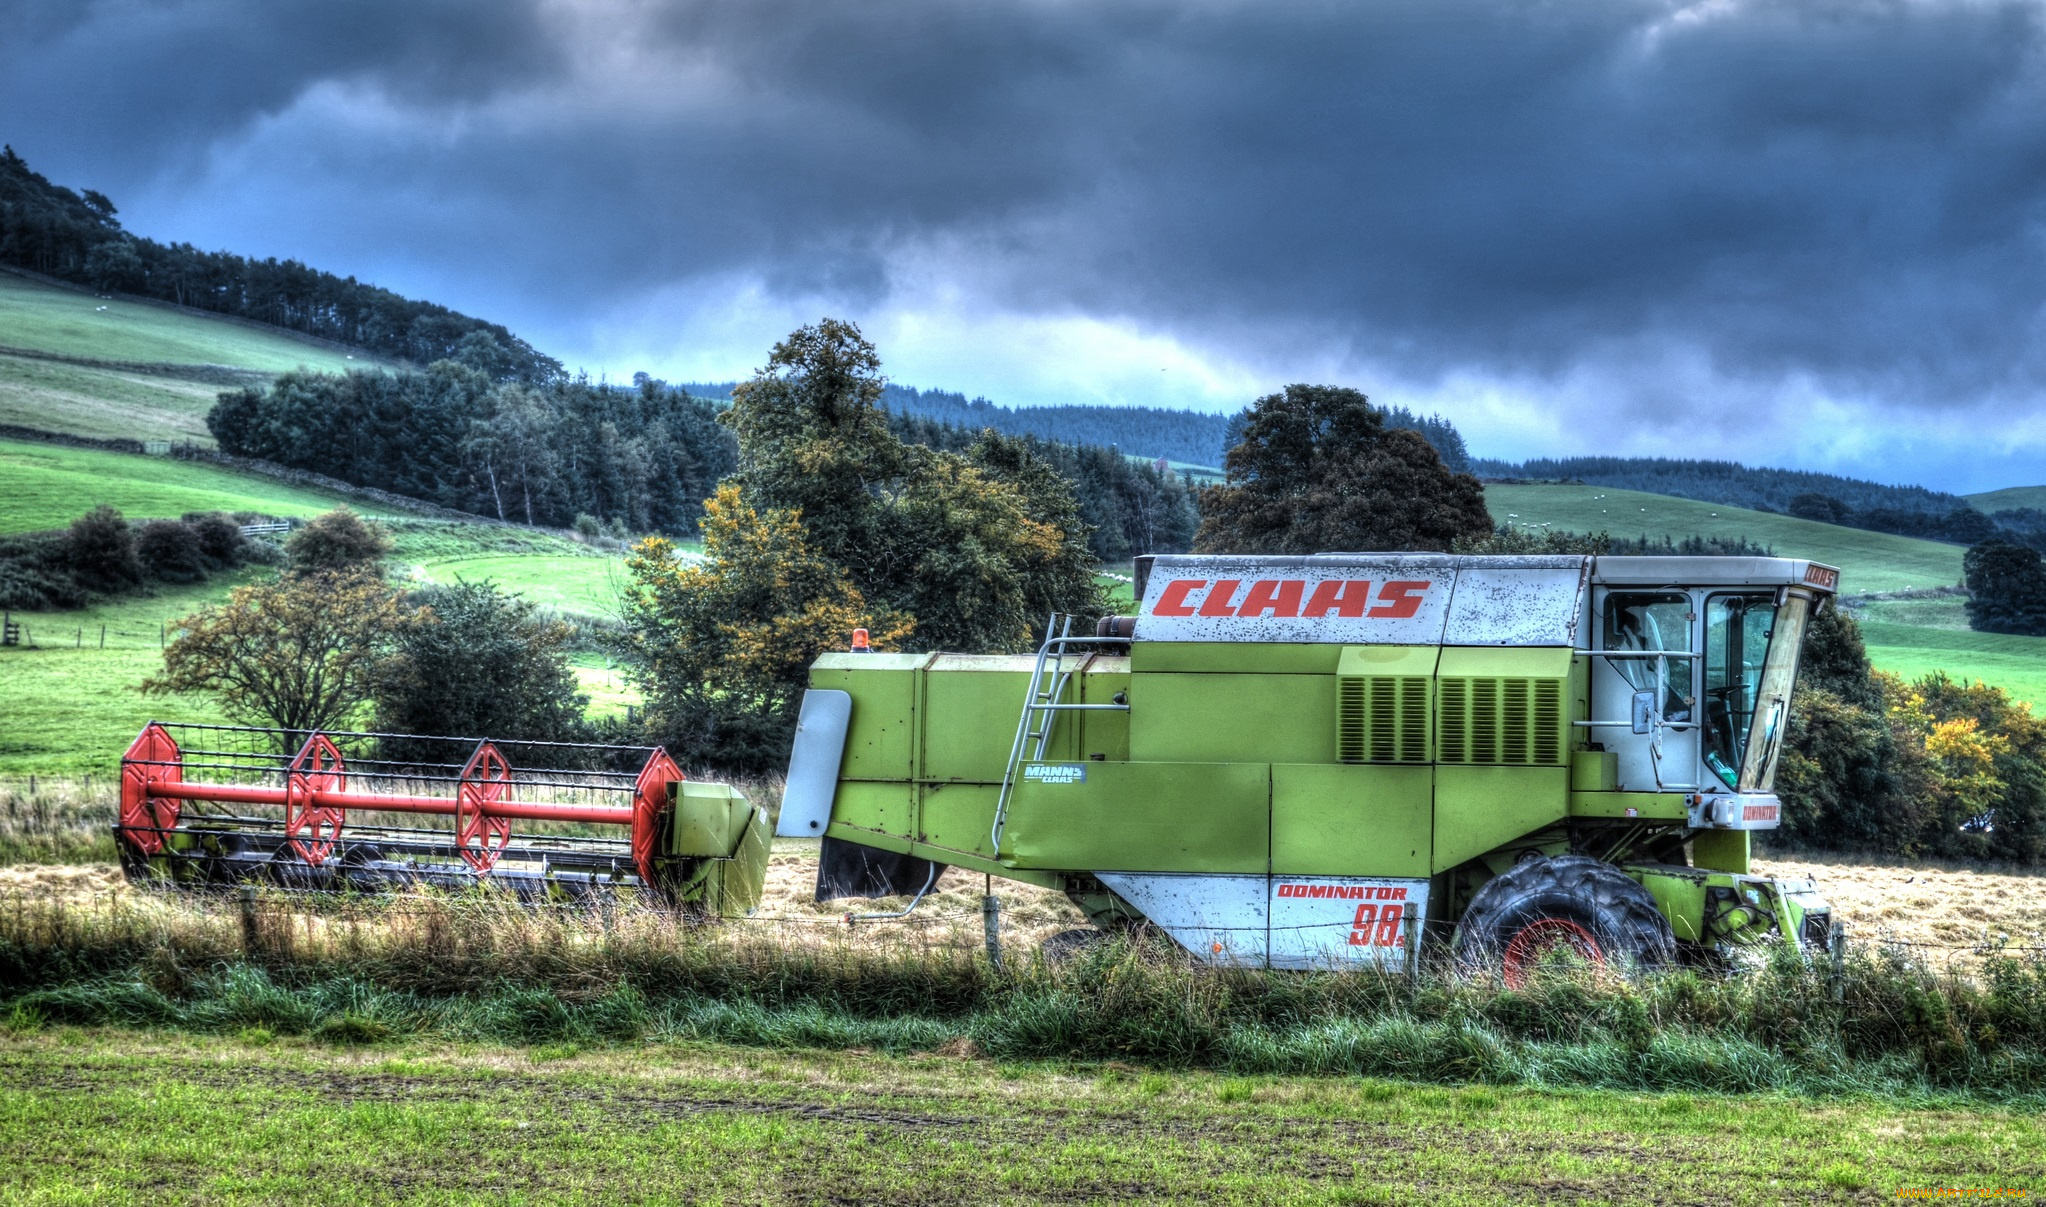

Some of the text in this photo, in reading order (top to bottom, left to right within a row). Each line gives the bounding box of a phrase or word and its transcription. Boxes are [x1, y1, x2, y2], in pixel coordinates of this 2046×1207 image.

[1152, 579, 1432, 618] CLAAS
[1024, 766, 1082, 777] MANNS
[1743, 805, 1777, 821] DOMINATOR
[1277, 884, 1408, 900] DOMINATOR
